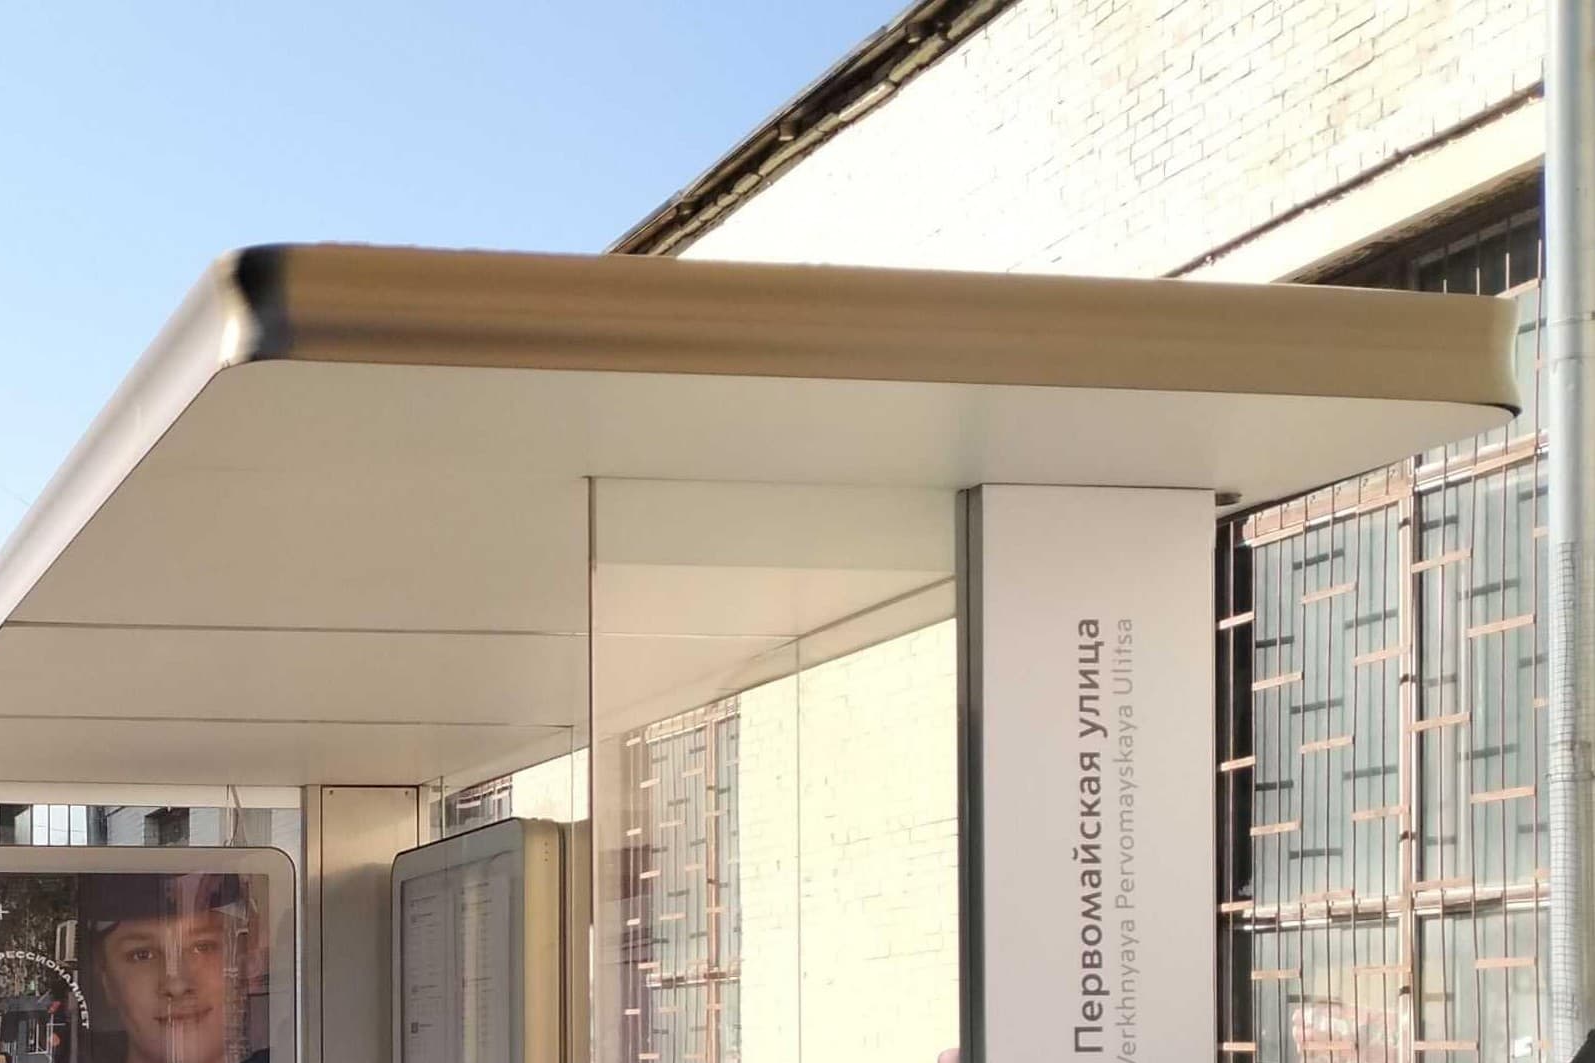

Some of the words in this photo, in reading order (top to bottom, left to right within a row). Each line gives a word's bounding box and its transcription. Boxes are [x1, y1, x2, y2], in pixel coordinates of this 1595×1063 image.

[1077, 617, 1108, 739] улица
[1110, 617, 1134, 695] Ulitsa
[1112, 704, 1139, 910] Pervomayskaya
[1072, 751, 1111, 1054] Первомайская
